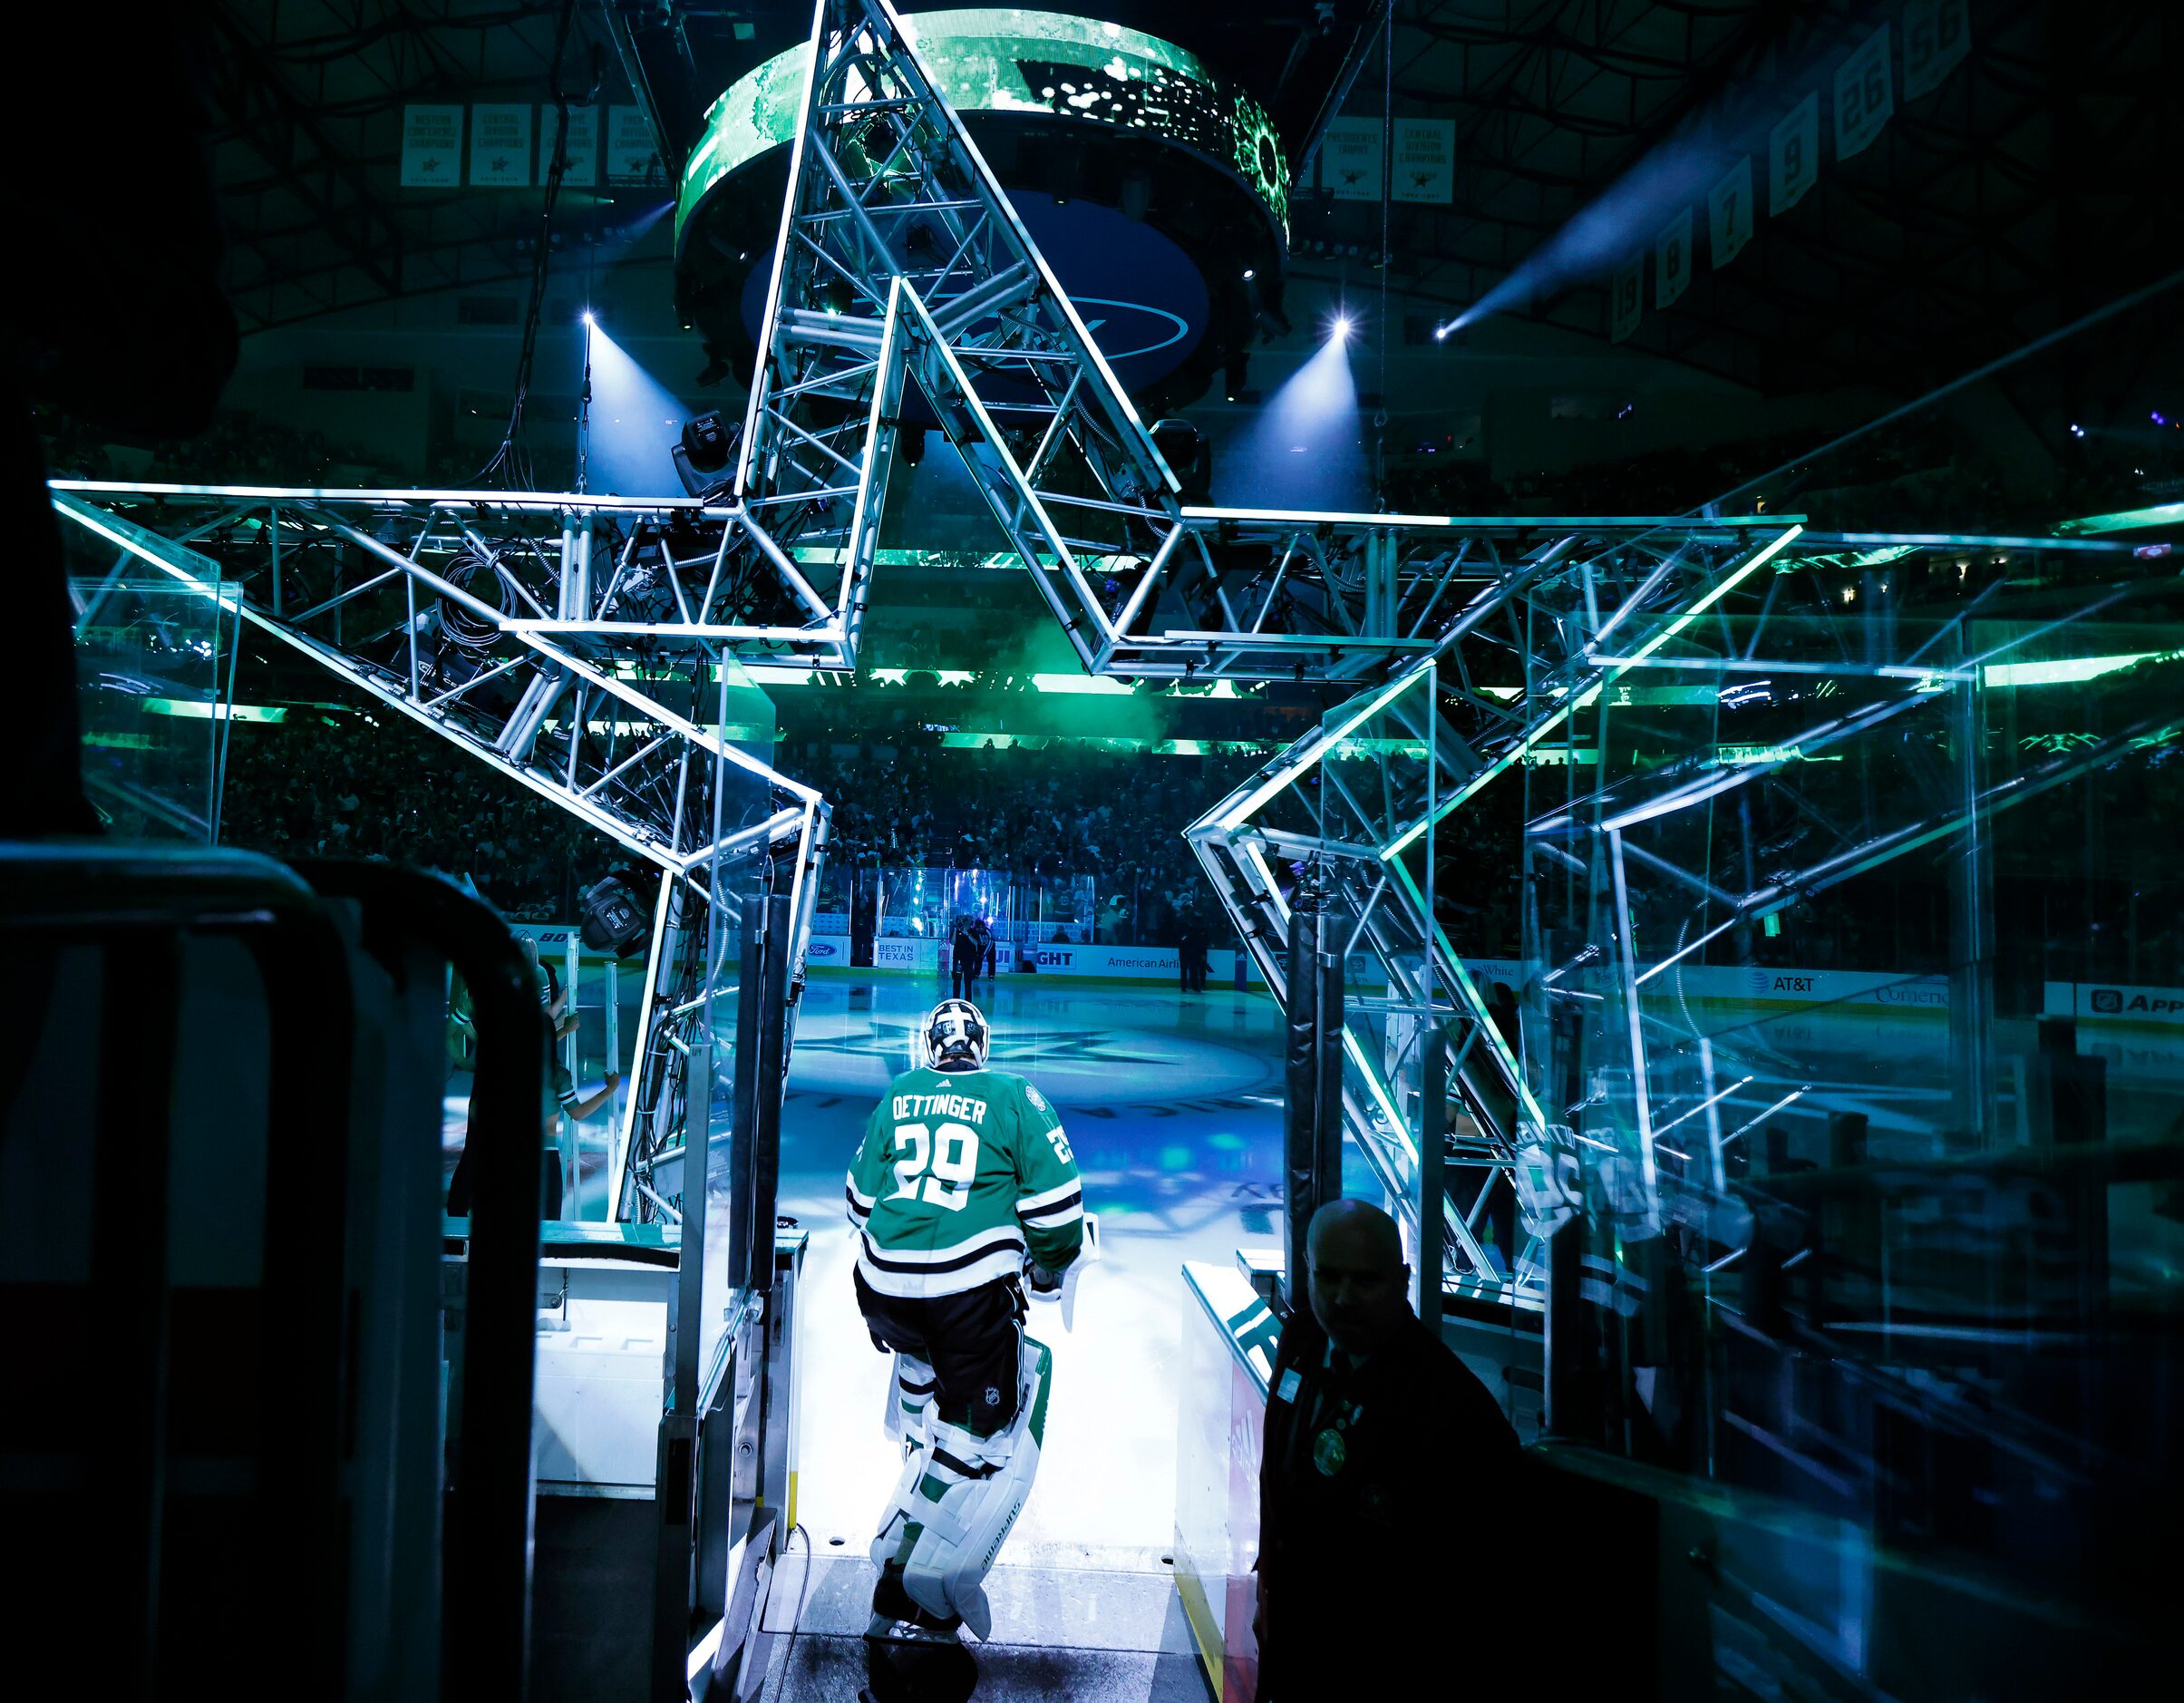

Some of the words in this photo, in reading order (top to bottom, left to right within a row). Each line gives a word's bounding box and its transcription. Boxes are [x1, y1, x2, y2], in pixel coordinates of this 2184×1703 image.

[1910, 0, 1961, 76] 56
[1842, 60, 1884, 136] 26
[1403, 130, 1442, 140] CENTRAL
[1406, 141, 1442, 151] DIVISION
[1399, 152, 1447, 164] CHAMPIONS
[1784, 135, 1801, 186] 9
[1723, 190, 1737, 238] 7
[1667, 238, 1680, 280] 8
[809, 945, 831, 956] Ford
[878, 953, 913, 961] TEXAS
[1108, 957, 1157, 968] American
[1159, 959, 1179, 969] Airli
[1773, 977, 1815, 992] AT&T
[893, 1094, 987, 1124] OETTINGER
[883, 1122, 980, 1212] 29
